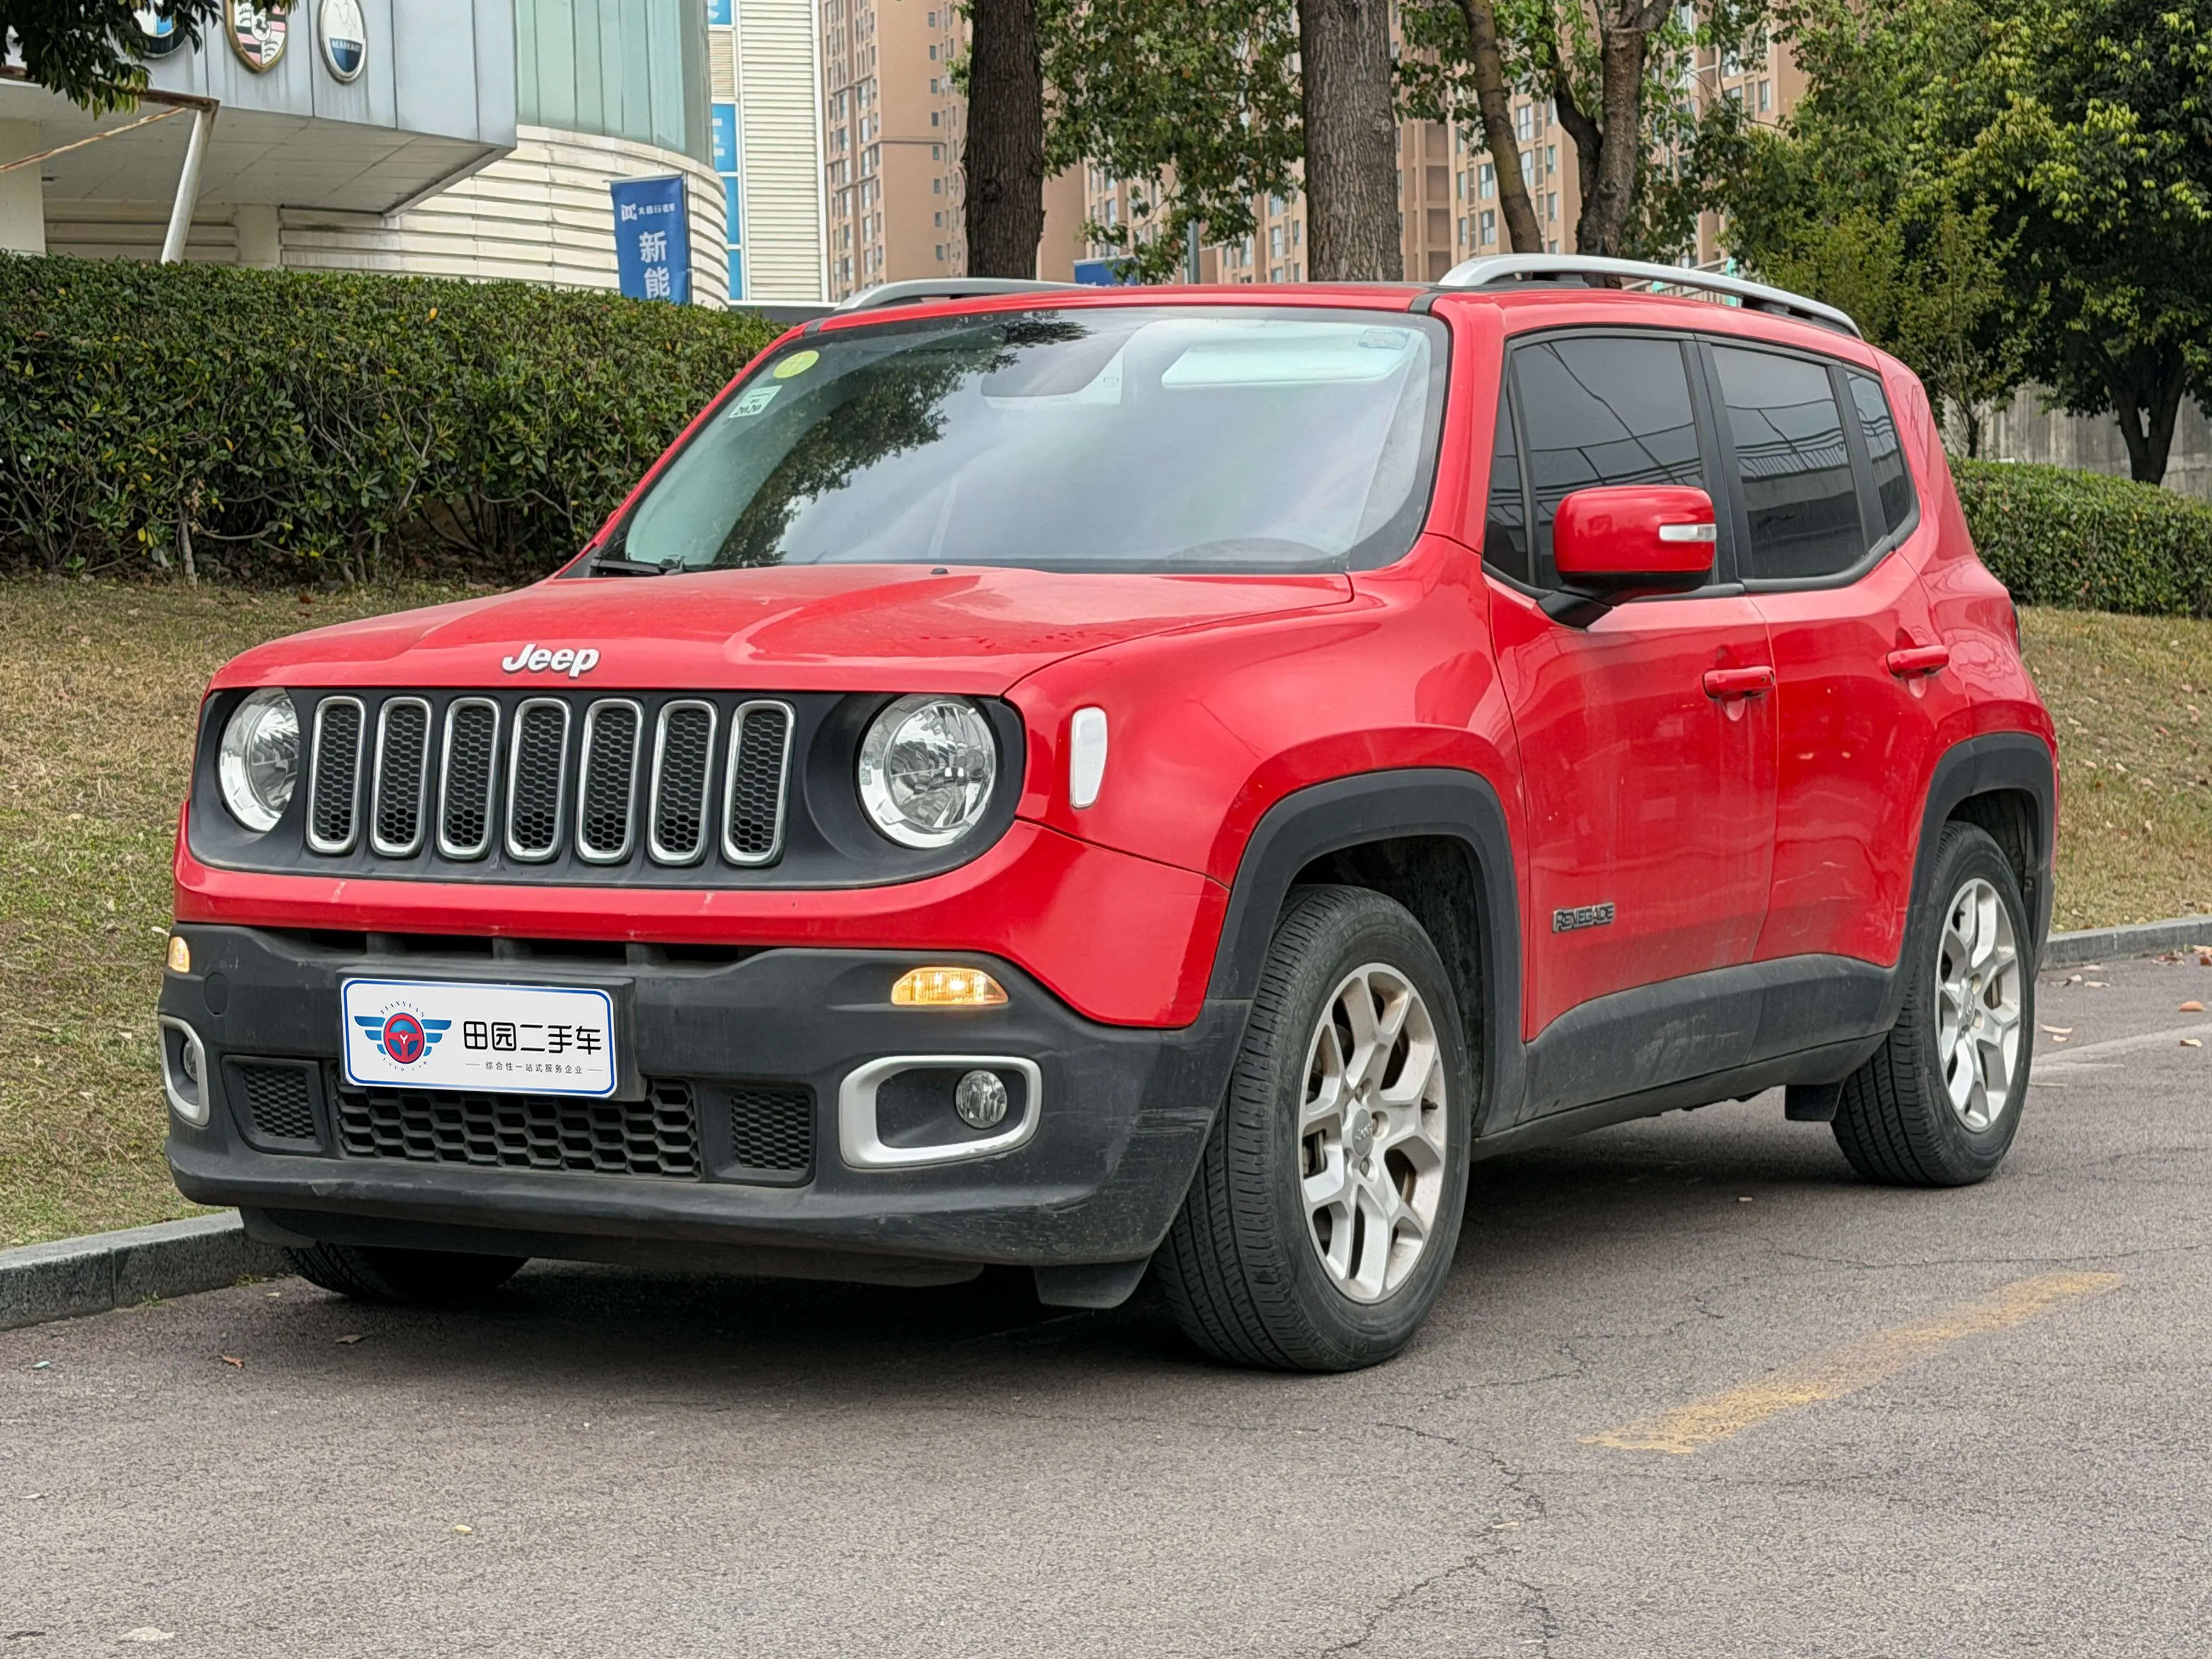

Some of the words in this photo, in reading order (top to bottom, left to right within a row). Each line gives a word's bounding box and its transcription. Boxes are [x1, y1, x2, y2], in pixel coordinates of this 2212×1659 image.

[639, 230, 670, 298] 新能
[501, 643, 600, 679] Jeep
[1553, 902, 1615, 933] RENEGADE
